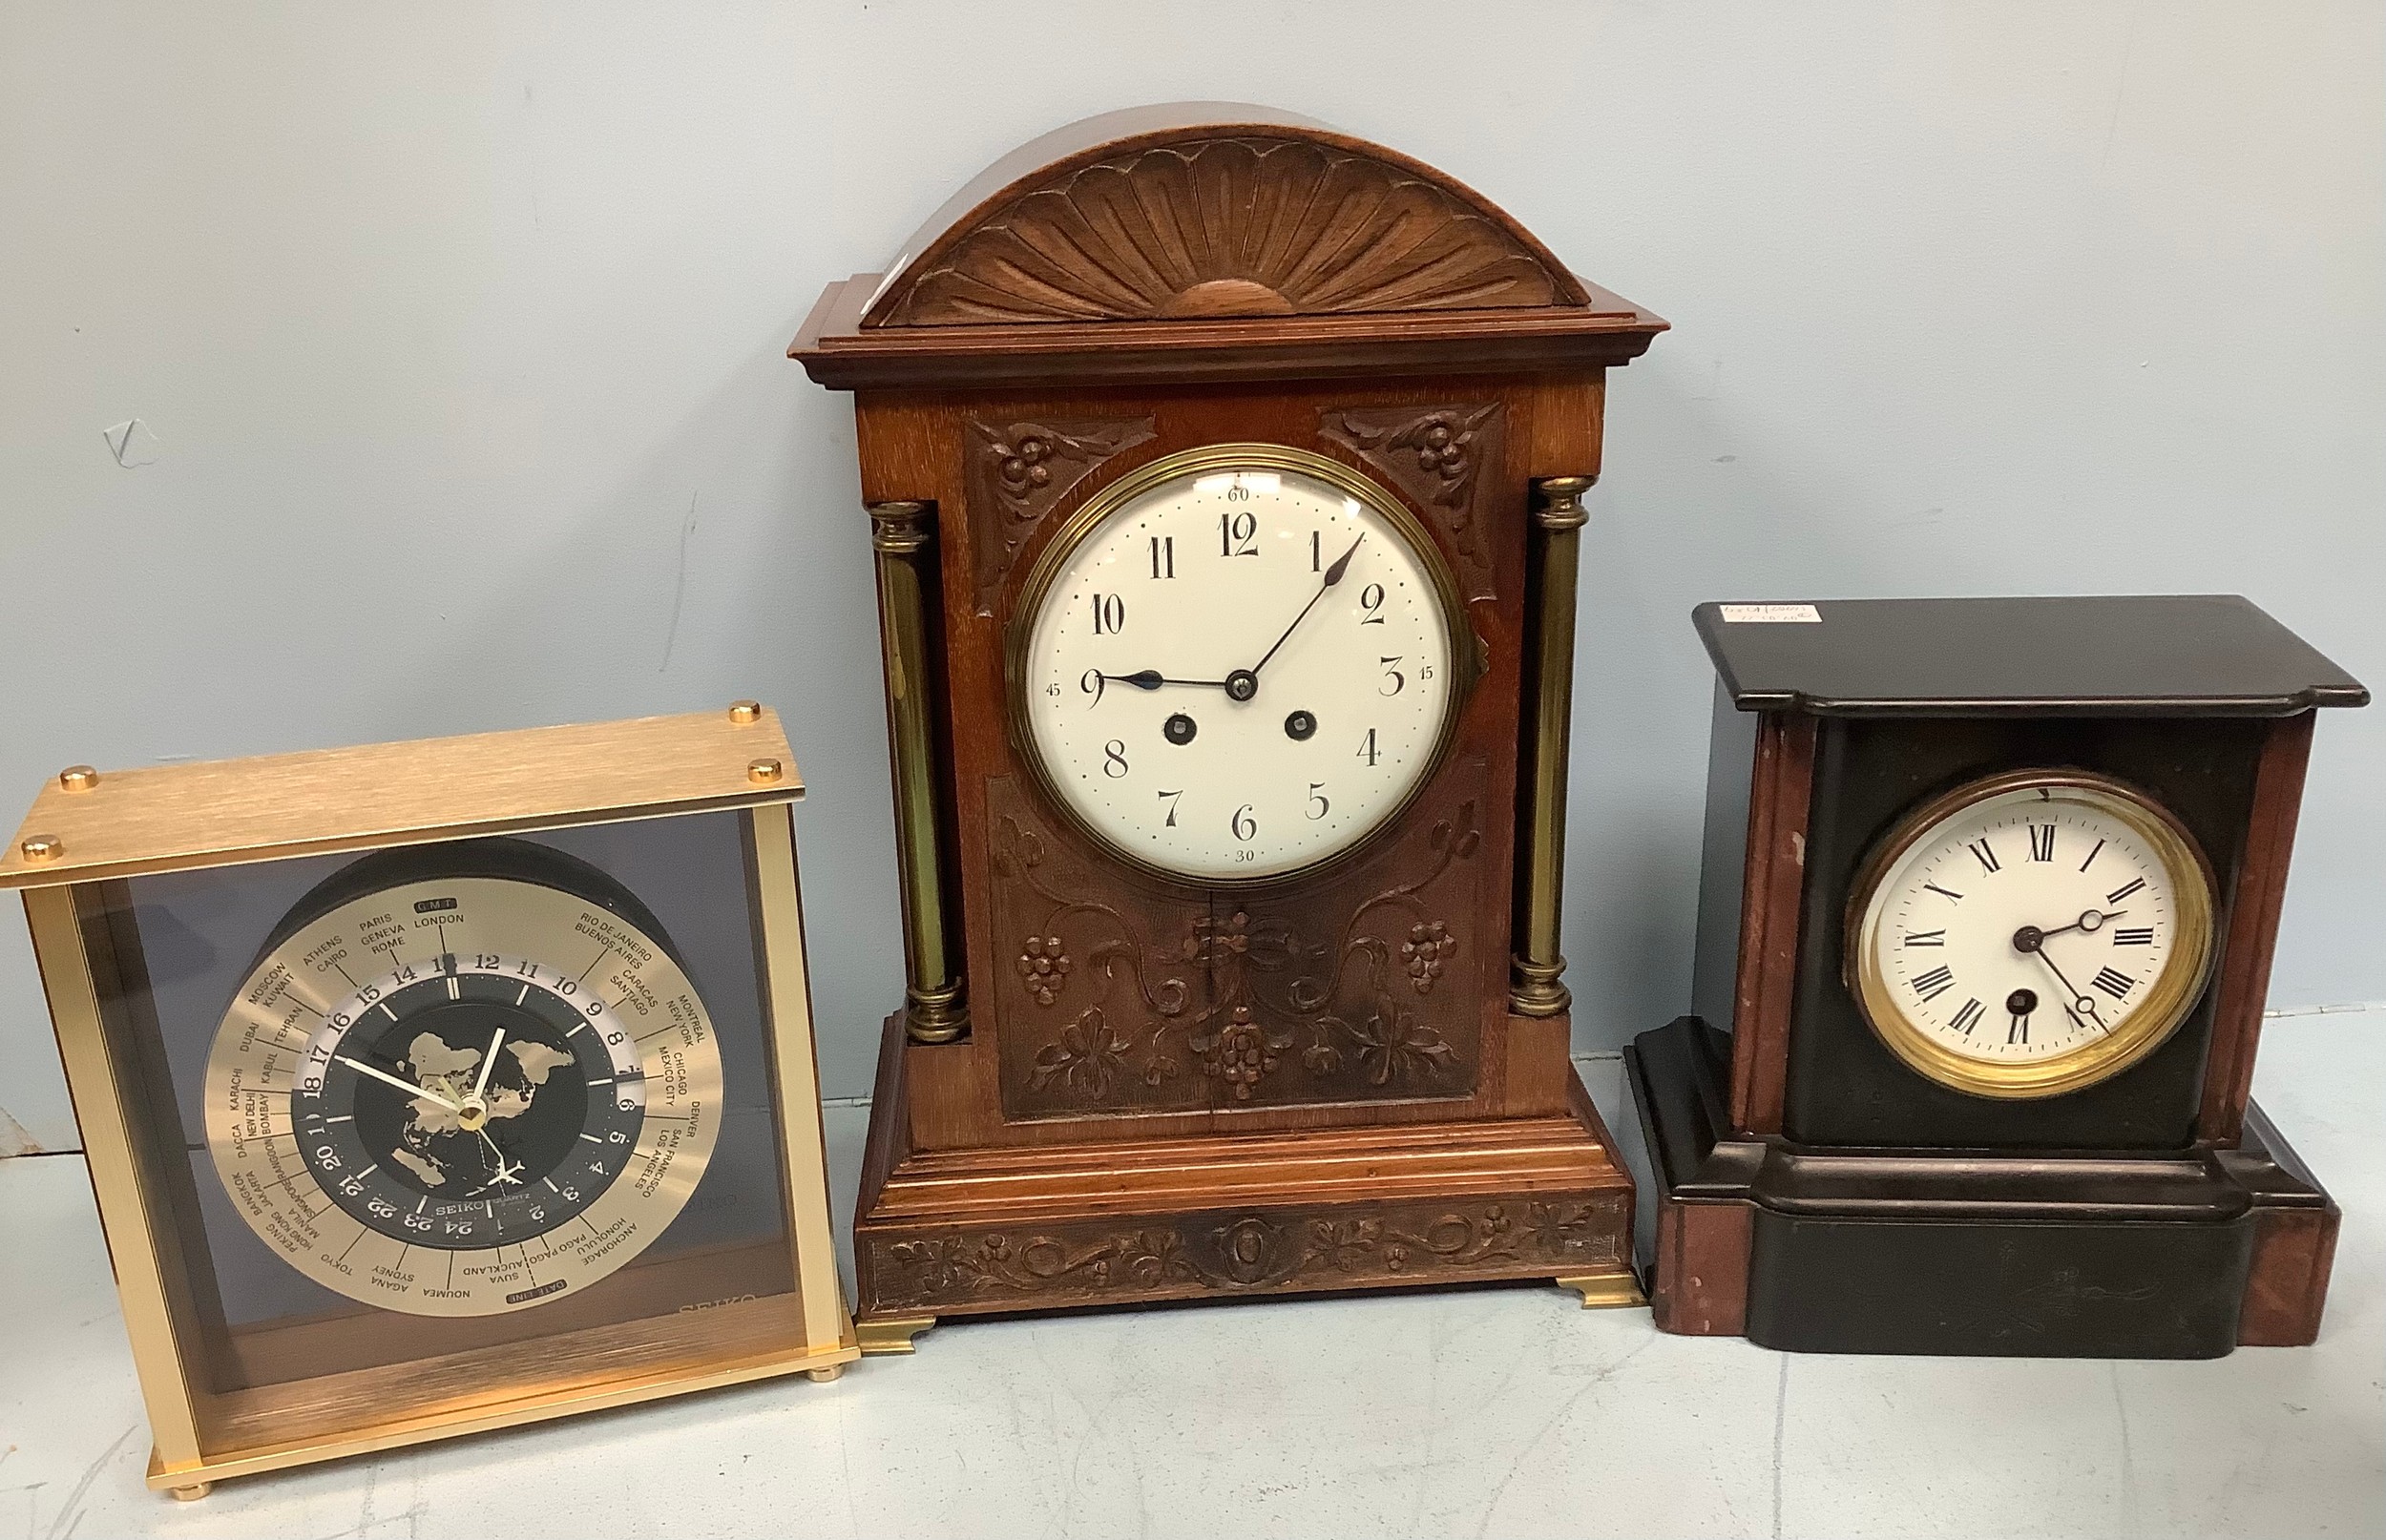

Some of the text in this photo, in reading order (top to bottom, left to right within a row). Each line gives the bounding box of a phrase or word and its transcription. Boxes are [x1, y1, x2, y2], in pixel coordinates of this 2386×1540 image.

[1228, 488, 1249, 502] 60
[1217, 512, 1259, 557] 12
[1147, 536, 1176, 579] 11
[1308, 531, 1323, 572] 1
[1090, 593, 1124, 635] 10
[1361, 583, 1385, 625] 2
[1378, 656, 1405, 697] 3
[1419, 666, 1434, 680] 15
[1046, 682, 1060, 697] 45
[1080, 668, 1105, 711] 9
[1103, 739, 1129, 779] 8
[1356, 728, 1382, 767] 4
[1158, 790, 1183, 827] 7
[1305, 782, 1330, 821] 5
[1231, 804, 1257, 842] 6
[1235, 850, 1254, 863] 30
[1968, 837, 2003, 878] XI
[2025, 824, 2057, 863] XII
[2079, 838, 2107, 873] I
[1923, 879, 1965, 906] X
[2105, 875, 2147, 906] II
[359, 913, 392, 931] PARIS
[361, 924, 406, 946] GENEVA
[414, 914, 464, 928] LONDON
[580, 912, 652, 962] RIO DE JANEIRO
[1904, 927, 1947, 947] IX
[2113, 926, 2154, 947] III
[303, 935, 343, 967] ATHENS
[317, 948, 347, 972] CAIRO
[371, 936, 406, 954] ROME
[575, 923, 643, 970] BUENOS AIRES
[391, 965, 418, 986] 14
[474, 954, 500, 970] 12
[517, 959, 539, 979] 11
[248, 962, 286, 1006] MOSCOW
[262, 972, 295, 1009] KUWAIT
[355, 984, 381, 1007] 15
[553, 976, 577, 995] 10
[610, 975, 649, 1016] SANTIAGO
[622, 969, 659, 1009] CARACAS
[1911, 963, 1957, 1003] VIII
[274, 1006, 303, 1043] TEHRAN
[327, 1011, 351, 1035] 16
[585, 1002, 602, 1017] 9
[666, 1000, 694, 1048] NEW YORK
[678, 994, 705, 1044] MONTREAL
[1948, 996, 1988, 1036] VII
[240, 1022, 260, 1052] DUBAI
[607, 1031, 624, 1046] 8
[261, 1052, 278, 1084] KABUL
[309, 1045, 330, 1067] 17
[303, 1076, 322, 1099] 18
[659, 1046, 675, 1107] MEXICO CITY
[674, 1051, 687, 1095] CHICAGO
[229, 1068, 243, 1112] KARACHI
[618, 1098, 636, 1112] 6
[245, 1092, 257, 1137] NEW DELHI
[260, 1093, 272, 1135] BOMBAY
[686, 1101, 701, 1138] DENVER
[232, 1124, 248, 1159] DACCA
[609, 1131, 627, 1144] 5
[264, 1137, 285, 1179] RANGOON
[316, 1145, 342, 1171] 20
[589, 1160, 604, 1175] 4
[635, 1129, 670, 1190] LOS ANGELES
[642, 1129, 682, 1198] SAN FRANCISCO
[231, 1172, 263, 1217] BANGKOK
[245, 1170, 274, 1208] JAKARTA
[280, 1178, 317, 1218] SINGAPORE
[339, 1175, 365, 1197] 21
[562, 1186, 578, 1201] 3
[288, 1207, 321, 1239] MANILA
[366, 1197, 398, 1218] 22
[404, 1213, 434, 1231] 23
[435, 1200, 484, 1216] SEIKO
[529, 1205, 545, 1220] 2
[265, 1223, 298, 1253] PEKING
[271, 1211, 314, 1251] HONG KONG
[444, 1220, 473, 1235] 24
[576, 1217, 627, 1256] HONOLULU
[529, 1233, 587, 1264] PAGO PAGO
[582, 1222, 638, 1266] ANCHORAGE
[321, 1254, 353, 1277] TOKYO
[371, 1264, 415, 1282] SYDNEY
[463, 1260, 523, 1276] AUCKLAND
[490, 1272, 519, 1284] SUVA
[370, 1276, 408, 1293] AGANA
[423, 1288, 471, 1299] NOUMEA
[509, 1280, 565, 1303] DATE LINE
